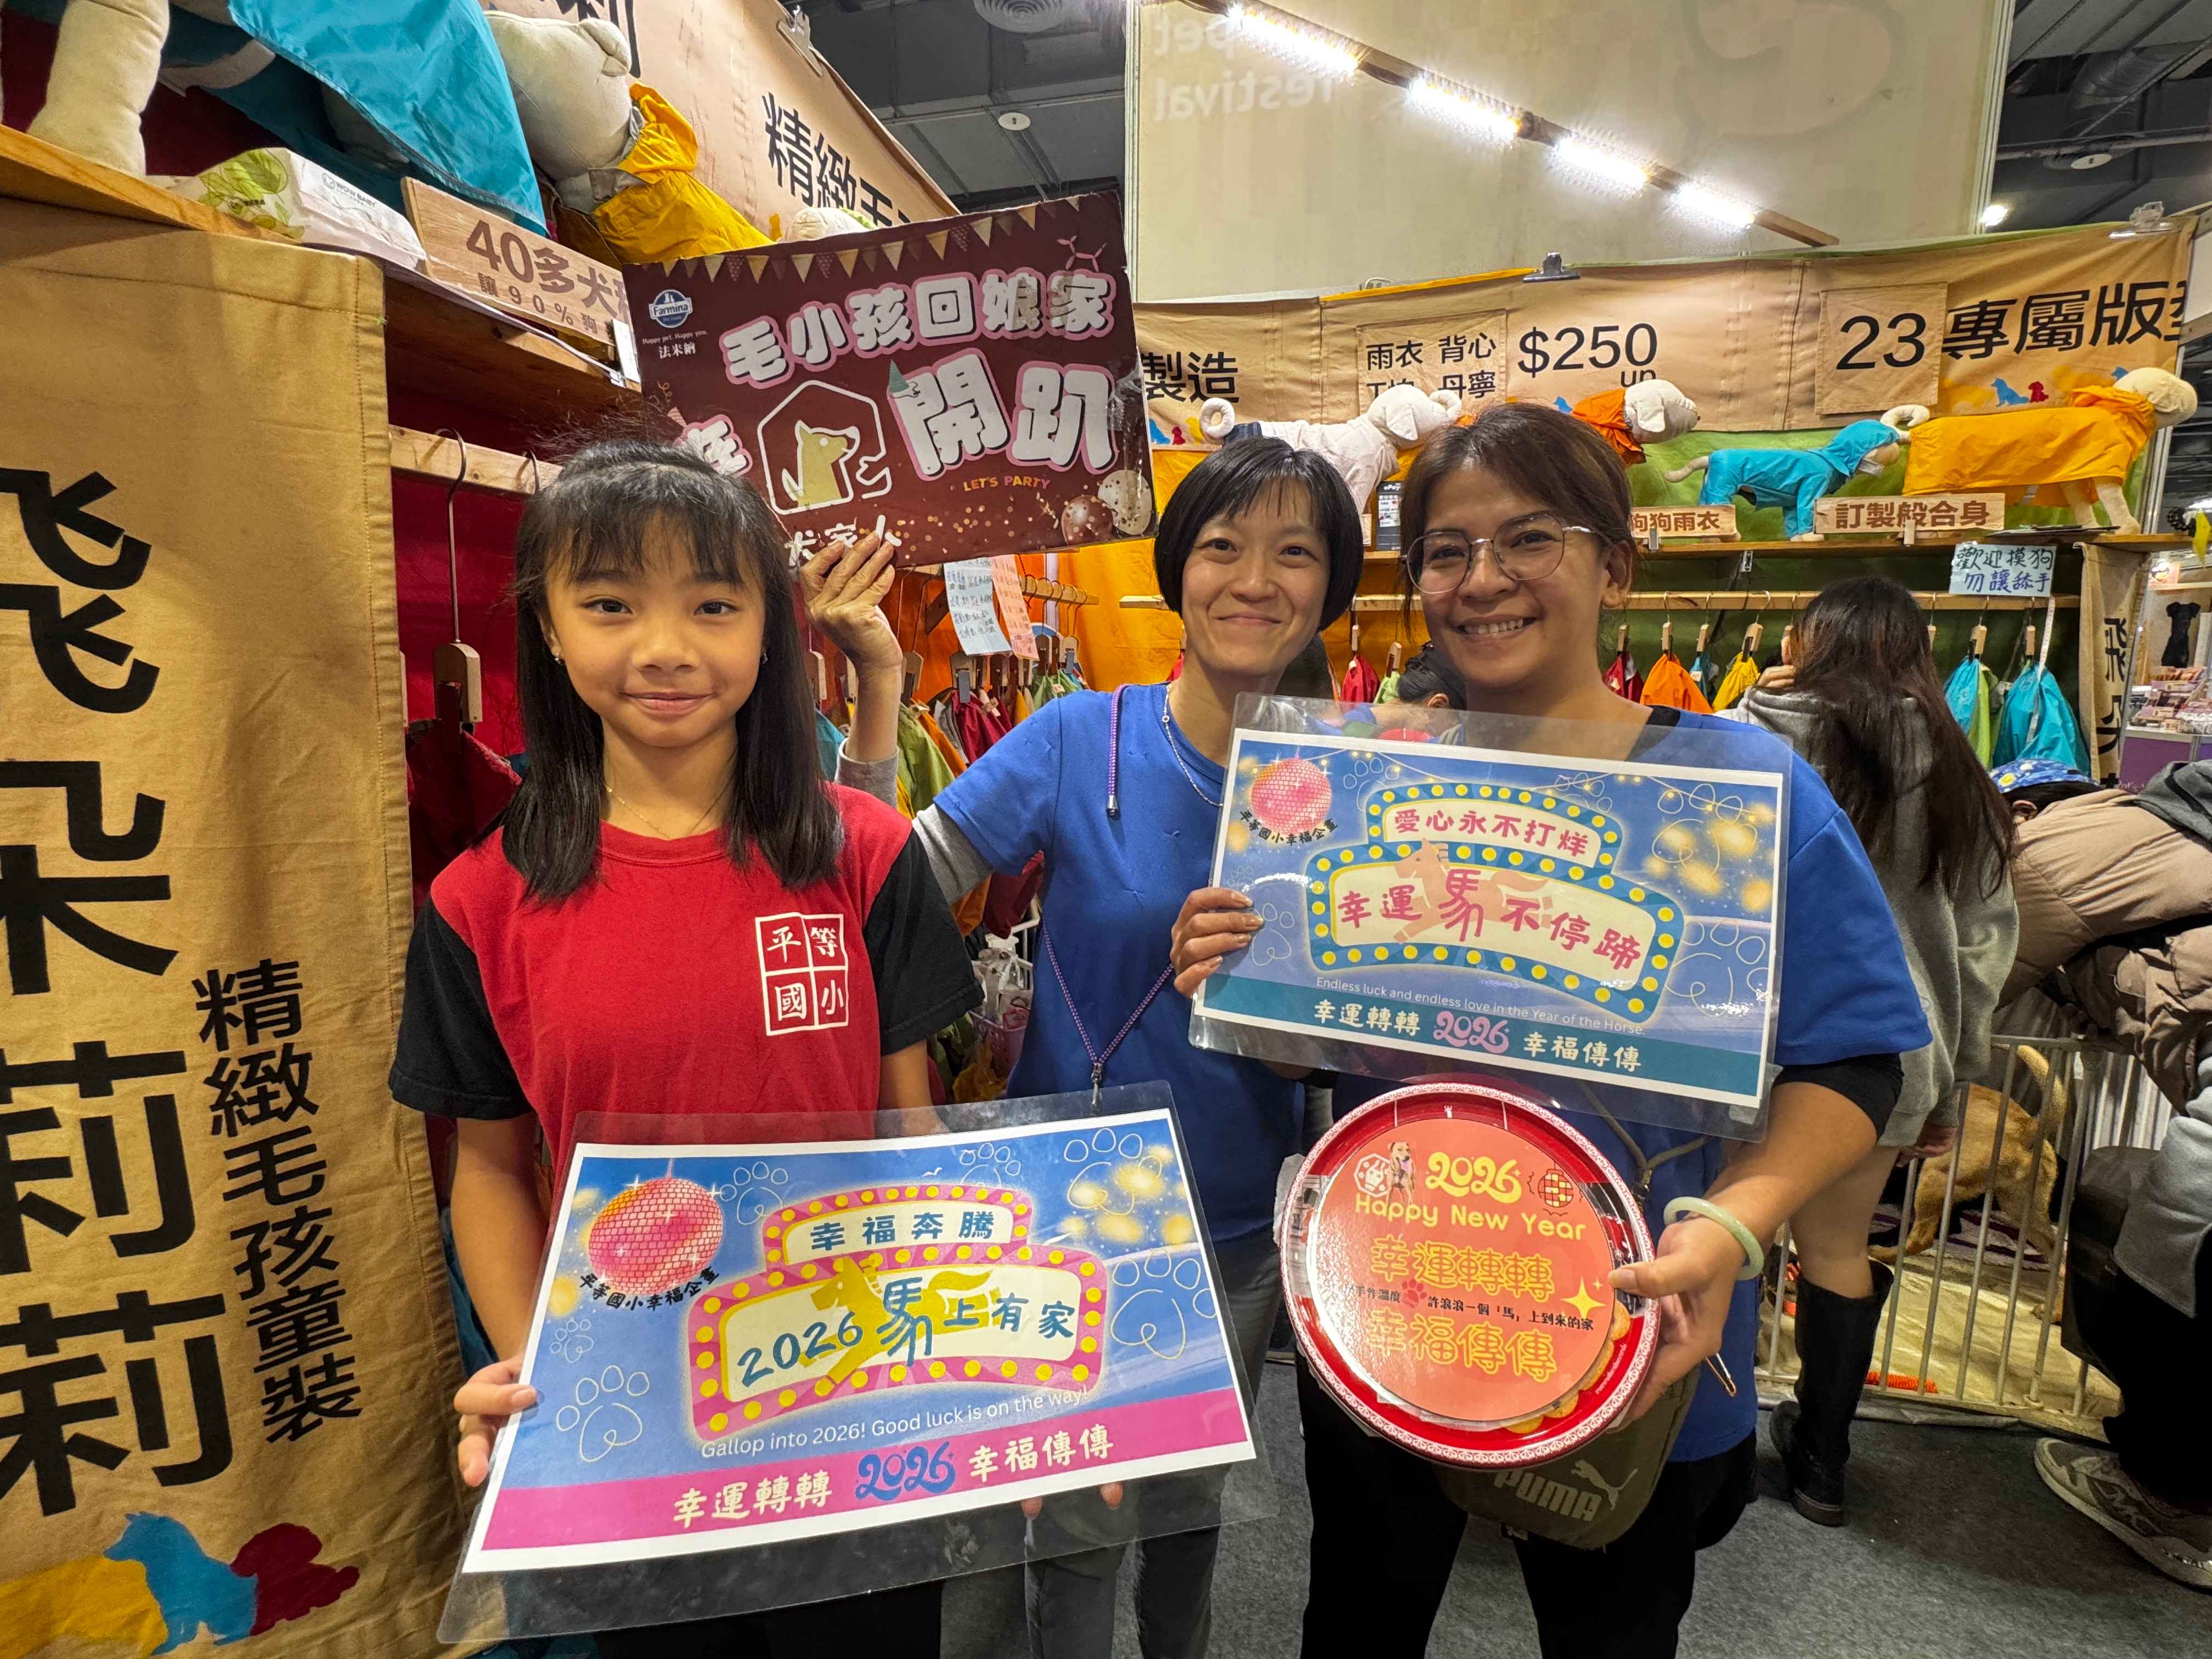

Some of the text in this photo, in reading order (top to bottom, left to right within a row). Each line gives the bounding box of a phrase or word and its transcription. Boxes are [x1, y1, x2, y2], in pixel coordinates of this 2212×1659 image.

[653, 303, 689, 316] Farmina
[722, 271, 1114, 384] 毛小孩回娘家
[659, 341, 696, 359] 法米納
[1367, 331, 1497, 371] 雨衣 背心
[1517, 323, 1657, 378] $250
[1837, 313, 1926, 370] 23
[900, 354, 1113, 475] 開趴
[963, 476, 1051, 492] LET'S PARTY
[1955, 547, 2054, 571] 歡迎摸狗
[1964, 570, 2051, 593] 勿讓舔手
[1395, 809, 1589, 857] 愛心永不打烊
[767, 926, 838, 963] 平等
[1338, 869, 1641, 969] 幸運馬不停蹄
[775, 980, 844, 1022] 國小
[1316, 977, 1646, 1035] Endless luck and endless love in the Year of the Horse.
[1314, 999, 1641, 1073] 幸運轉轉 2026 幸福傳傳
[190, 958, 363, 1443] 精緻毛孩童裝
[1425, 1152, 1522, 1204] 2026
[811, 1211, 994, 1251] 幸福奔騰
[1355, 1193, 1586, 1240] Happy New Year
[1371, 1234, 1555, 1303] 幸運轉轉
[1367, 1307, 1557, 1383] 幸福傳傳
[702, 1386, 1088, 1459] Gallop into 2026! Good luck is on the way!
[674, 1424, 1114, 1527] 幸運轉轉 2026 幸福傳傳
[1493, 1470, 1601, 1521] PUMA
